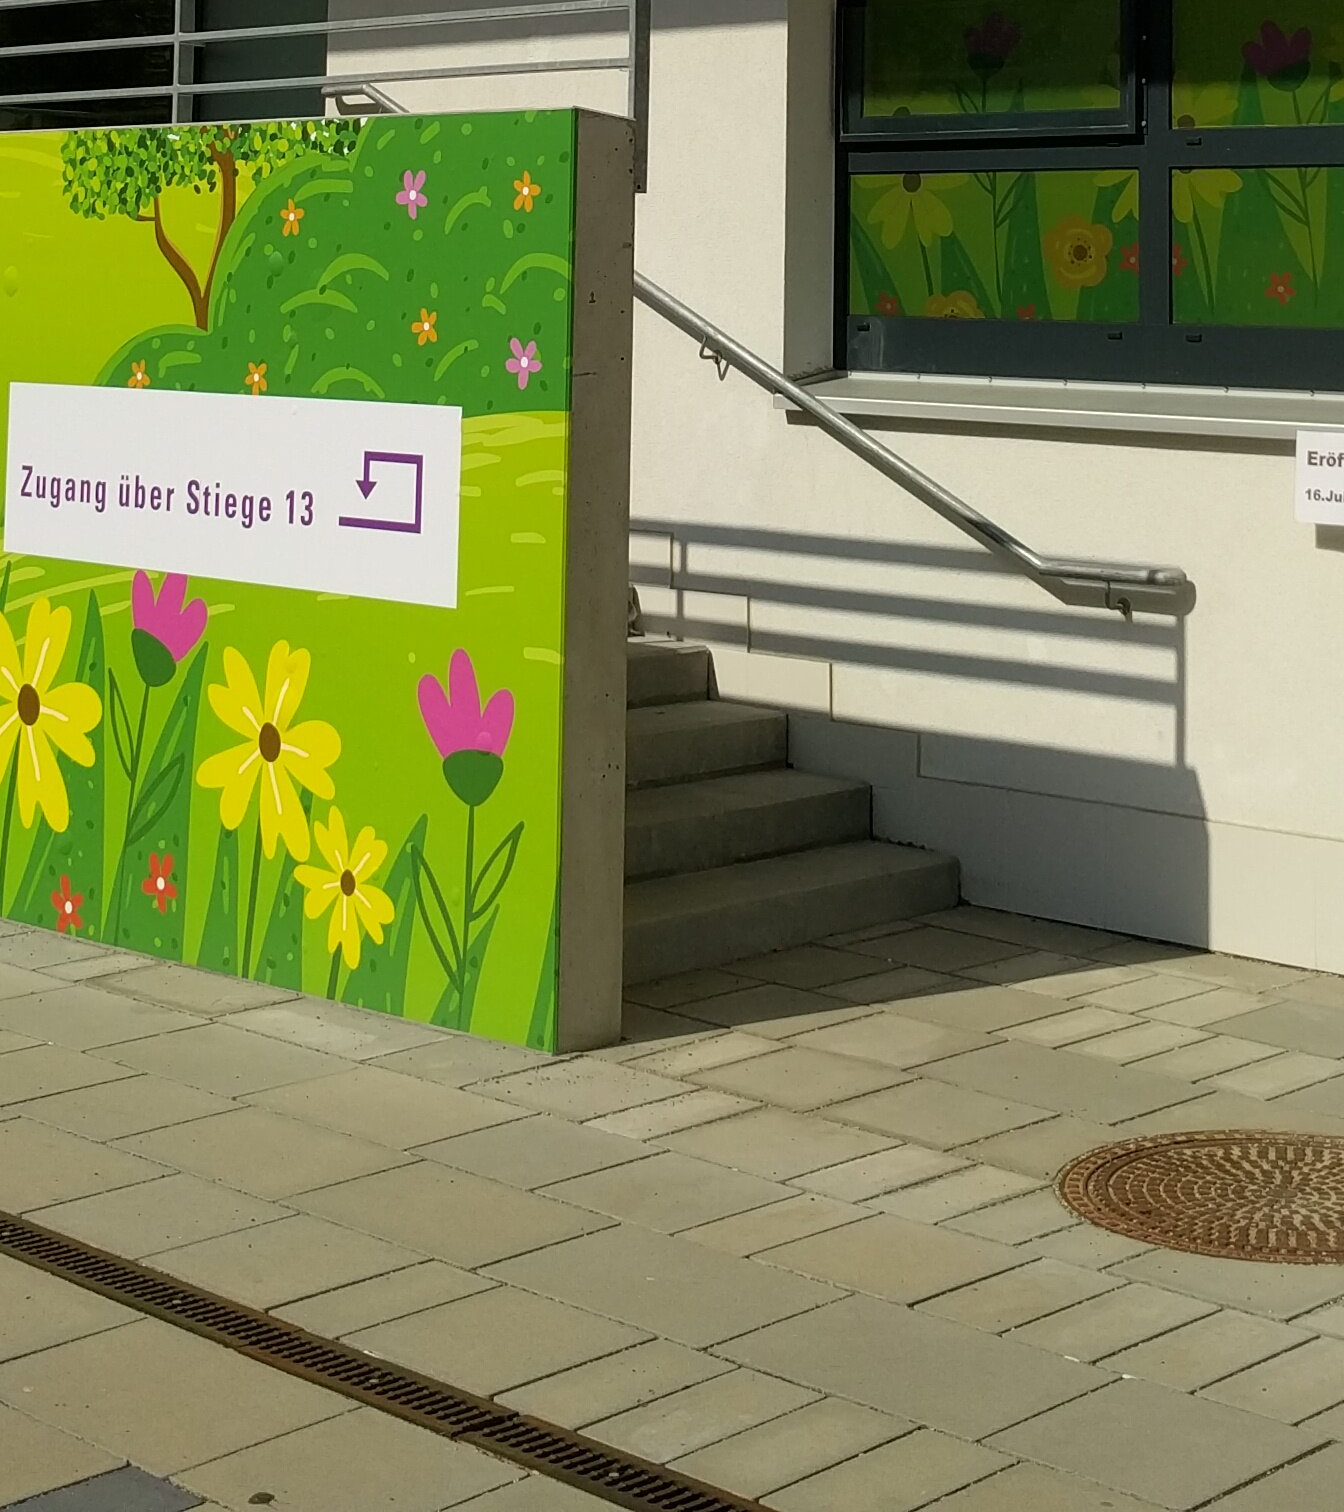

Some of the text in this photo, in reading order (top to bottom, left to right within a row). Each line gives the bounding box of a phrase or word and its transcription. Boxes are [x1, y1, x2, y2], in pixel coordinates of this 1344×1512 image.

[19, 465, 315, 529] Zugang über Stiege 13
